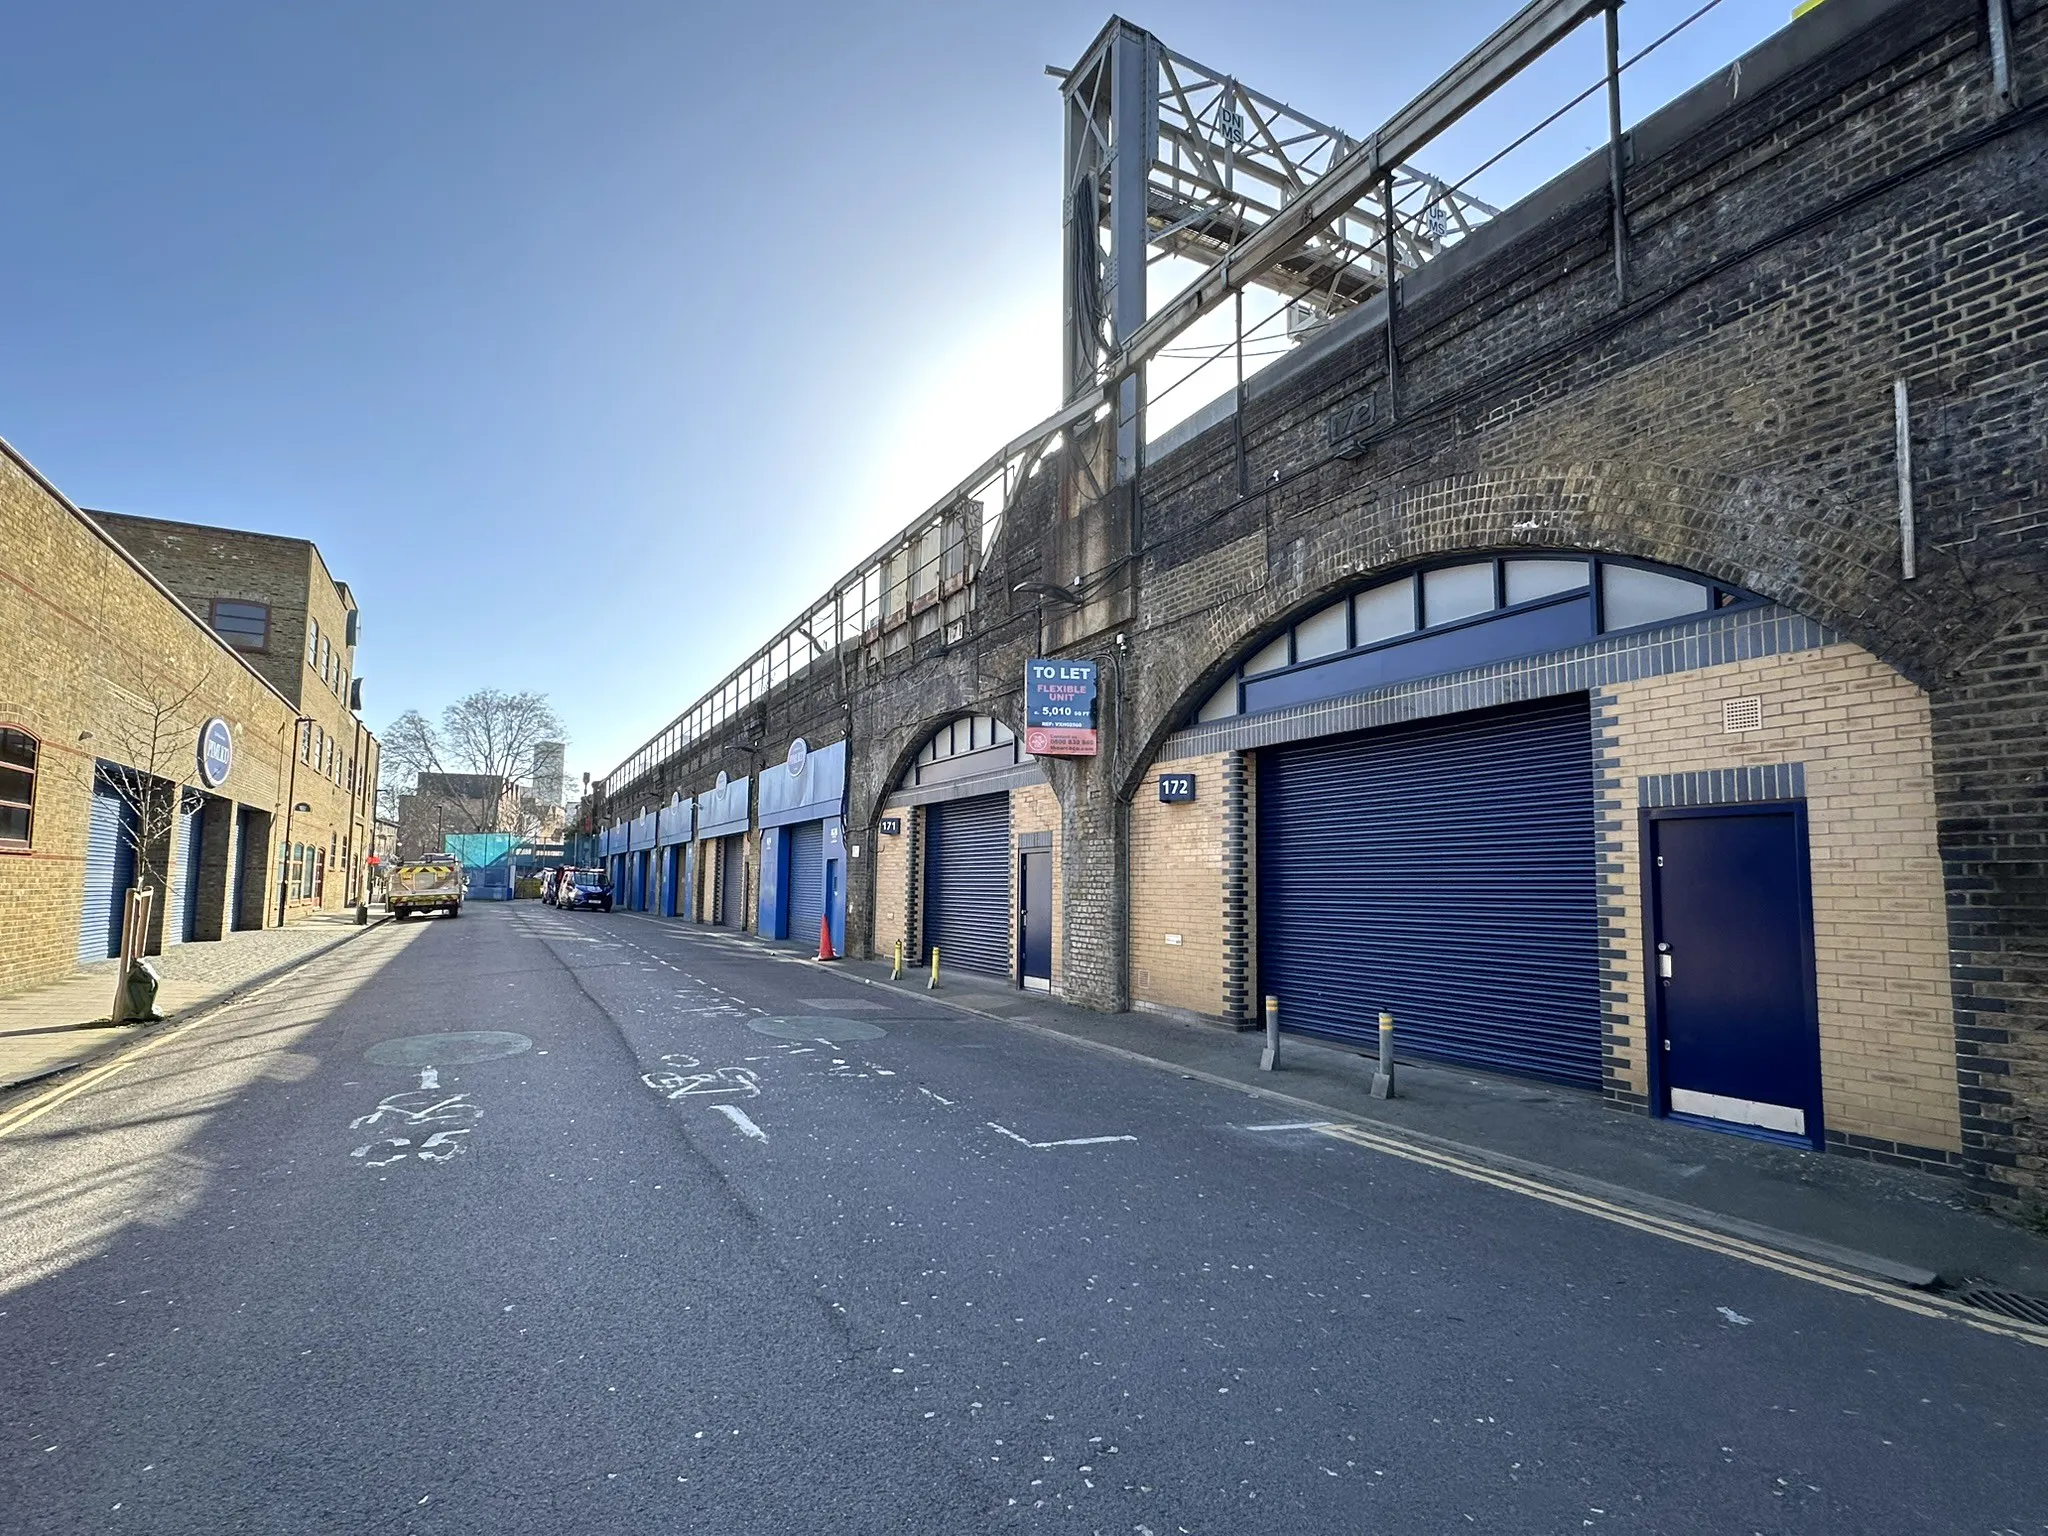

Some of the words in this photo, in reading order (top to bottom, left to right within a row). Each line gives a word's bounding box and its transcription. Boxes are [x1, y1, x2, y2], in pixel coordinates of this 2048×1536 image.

[1222, 109, 1241, 128] DN
[1221, 123, 1242, 143] MS
[1429, 207, 1444, 220] UP
[1429, 219, 1446, 235] MS
[1033, 666, 1056, 679] TO
[1060, 667, 1091, 680] LET
[1037, 684, 1087, 694] FLEXIBLE
[1049, 693, 1075, 701] UNIT
[1042, 706, 1072, 717] 5,010
[1162, 779, 1188, 795] 172
[882, 821, 896, 831] 171
